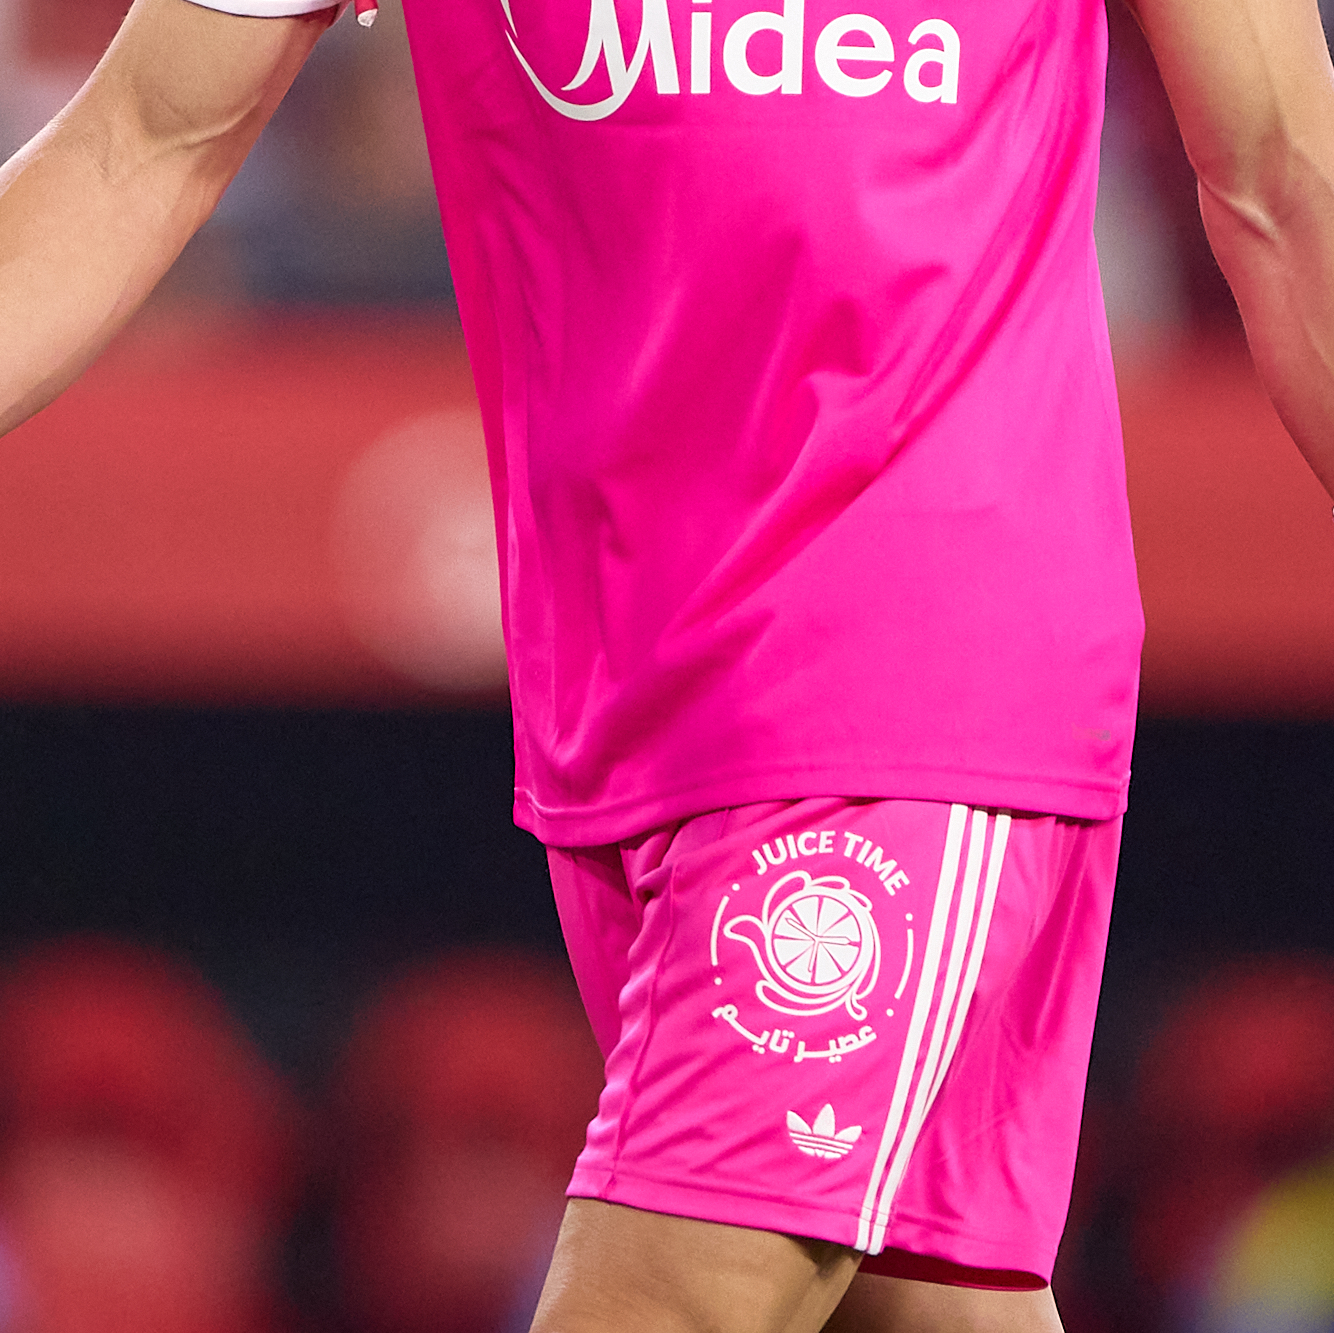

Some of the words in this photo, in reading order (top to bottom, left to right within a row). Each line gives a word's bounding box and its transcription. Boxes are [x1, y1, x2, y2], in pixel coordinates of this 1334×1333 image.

[751, 830, 837, 876] JUICE
[843, 830, 911, 897] TIME
[711, 1003, 796, 1055] تايم
[793, 1024, 878, 1064] عصير
